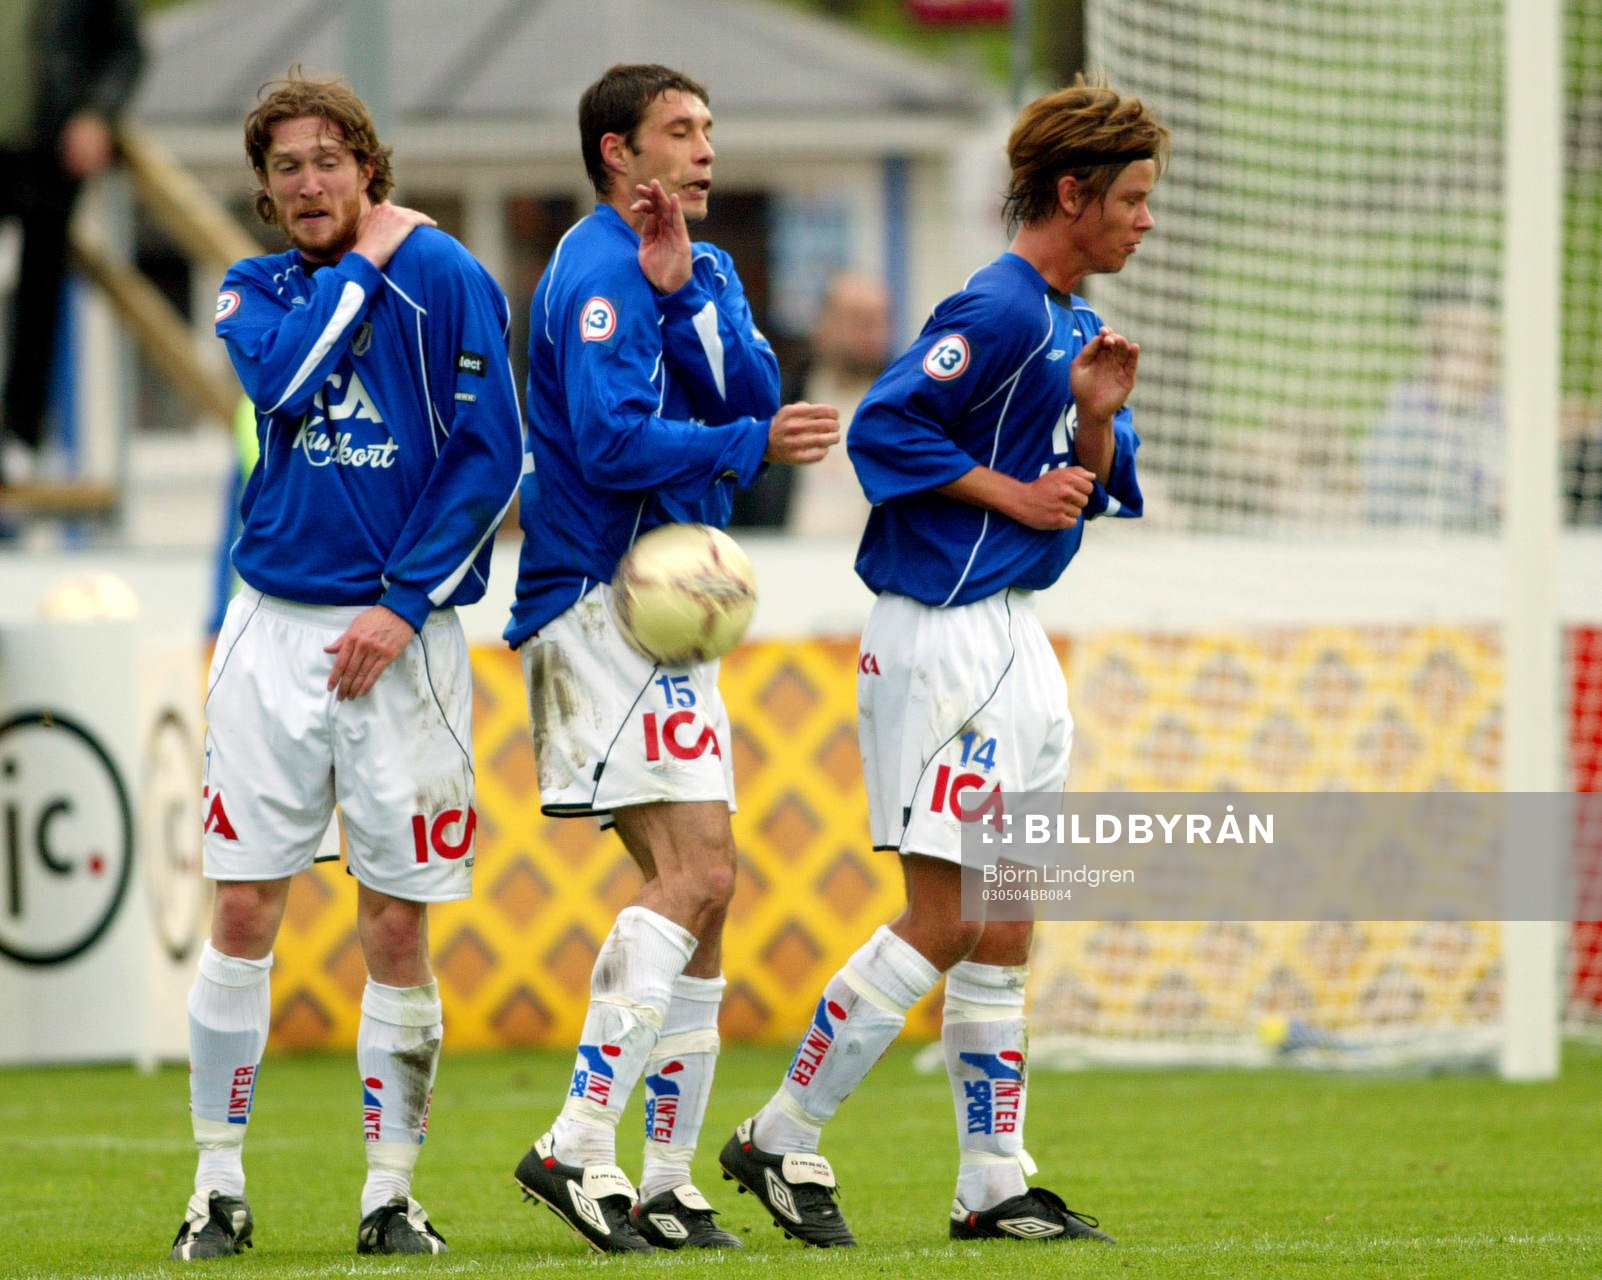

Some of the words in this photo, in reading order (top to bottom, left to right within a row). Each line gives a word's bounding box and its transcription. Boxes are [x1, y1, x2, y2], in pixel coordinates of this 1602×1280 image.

[459, 355, 482, 371] lect
[931, 344, 962, 370] 13
[313, 370, 384, 424] CA
[655, 674, 697, 708] 15
[960, 731, 997, 774] 14
[930, 763, 1004, 835] ICA
[792, 1027, 833, 1088] INTER
[228, 1065, 254, 1115] INTER
[964, 1080, 993, 1135] SPORT
[994, 1080, 1020, 1134] INTER
[364, 1106, 382, 1142] INTE
[655, 1097, 679, 1144] INTE
